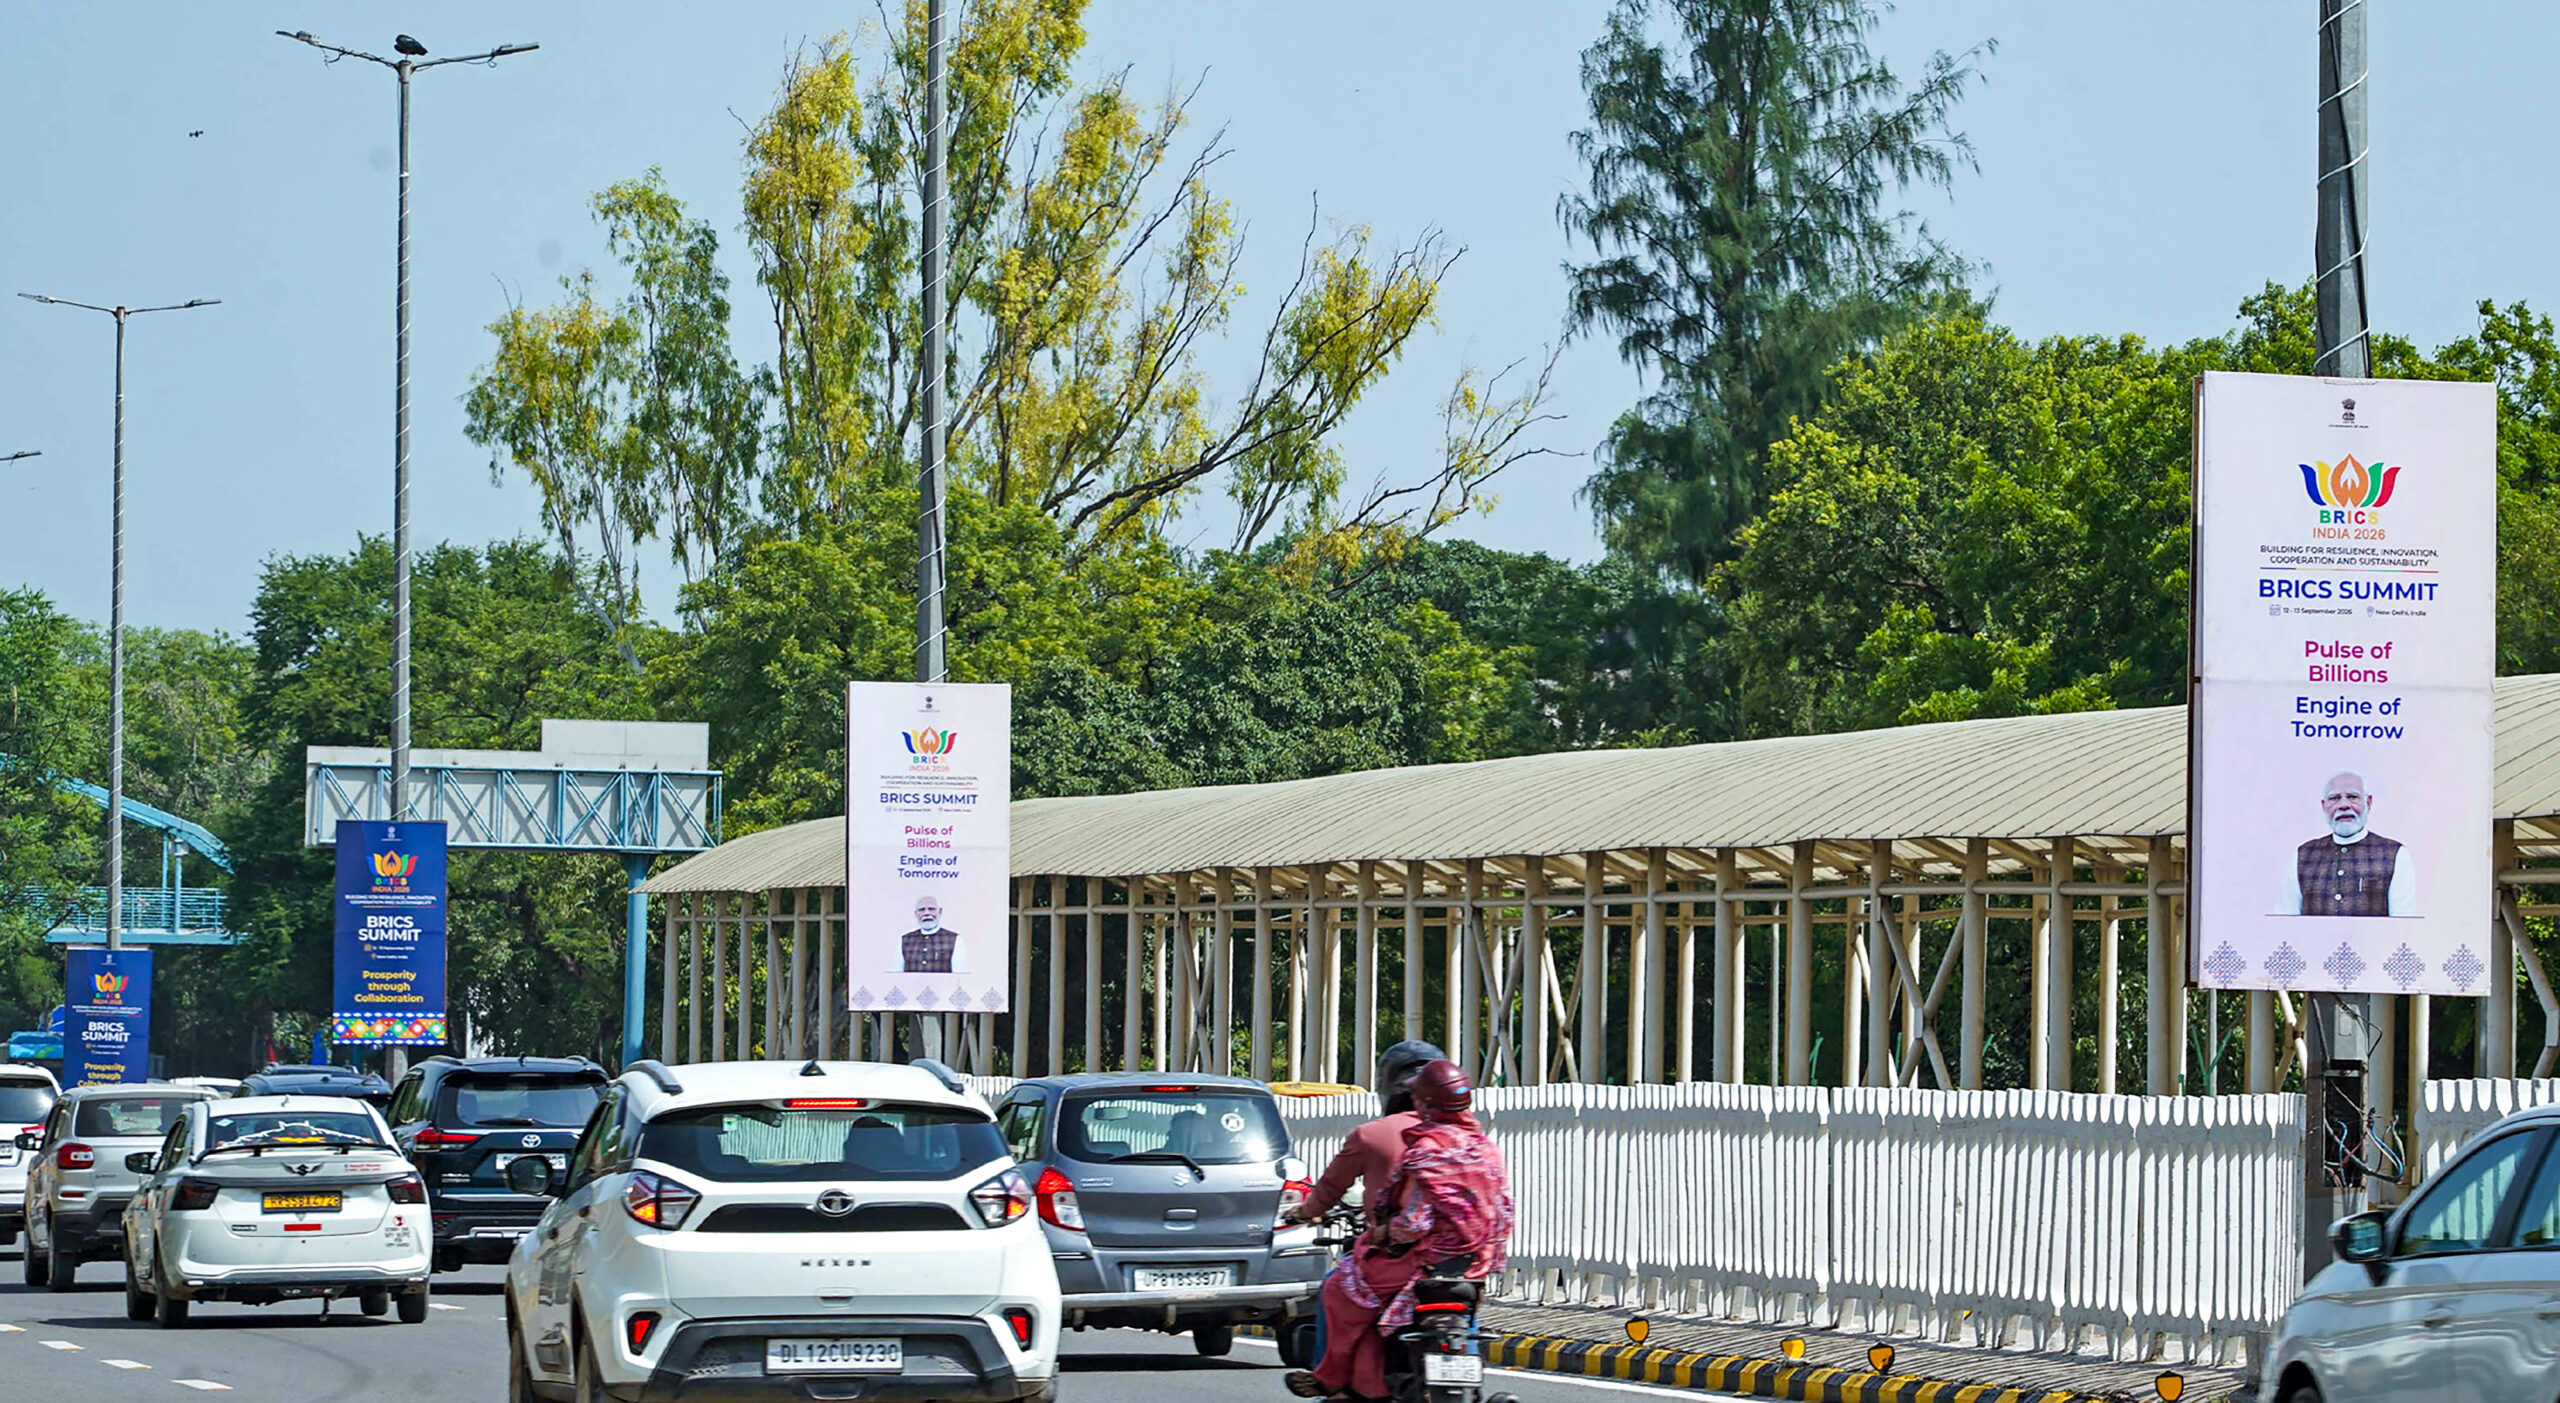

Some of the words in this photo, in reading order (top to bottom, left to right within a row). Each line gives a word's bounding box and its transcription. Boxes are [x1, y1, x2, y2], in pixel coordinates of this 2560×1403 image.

[2319, 510, 2379, 525] BRICS
[2312, 527, 2350, 540] INDIA
[2353, 528, 2386, 540] 2026
[2260, 545, 2303, 554] BUILDING
[2305, 546, 2324, 555] FOR
[2326, 546, 2379, 556] RESILIENCE,
[2381, 548, 2439, 558] INNOVATION,
[2270, 556, 2335, 565] COOPERATION
[2337, 557, 2357, 565] AND
[2359, 557, 2429, 567] SUSTAINABILITY
[2259, 578, 2332, 599] BRICS
[2339, 580, 2439, 601] SUMMIT
[2301, 608, 2336, 616] September
[2305, 640, 2364, 659] Pulse
[2370, 641, 2393, 659] of
[2309, 664, 2389, 683] Billions
[2296, 695, 2373, 718] Engine
[2379, 697, 2402, 715] of
[2291, 720, 2404, 739] Tomorrow
[880, 792, 920, 804] BRICS
[923, 793, 978, 805] SUMMIT
[904, 825, 938, 836] Pulse
[941, 825, 954, 836] of
[907, 838, 951, 848] Billions
[900, 854, 942, 867] Engine
[945, 855, 958, 866] of
[897, 868, 960, 878] Tomorrow
[366, 915, 414, 928] BRICS
[358, 928, 422, 942] SUMMIT
[362, 969, 417, 981] Prosperity
[368, 982, 411, 993] through
[354, 993, 424, 1003] Collaboration
[88, 1021, 125, 1032] BRICS
[81, 1031, 131, 1043] SUMMIT
[84, 1063, 125, 1073] Prosperity
[88, 1072, 121, 1080] through
[780, 1344, 898, 1362] DL12CU9230
